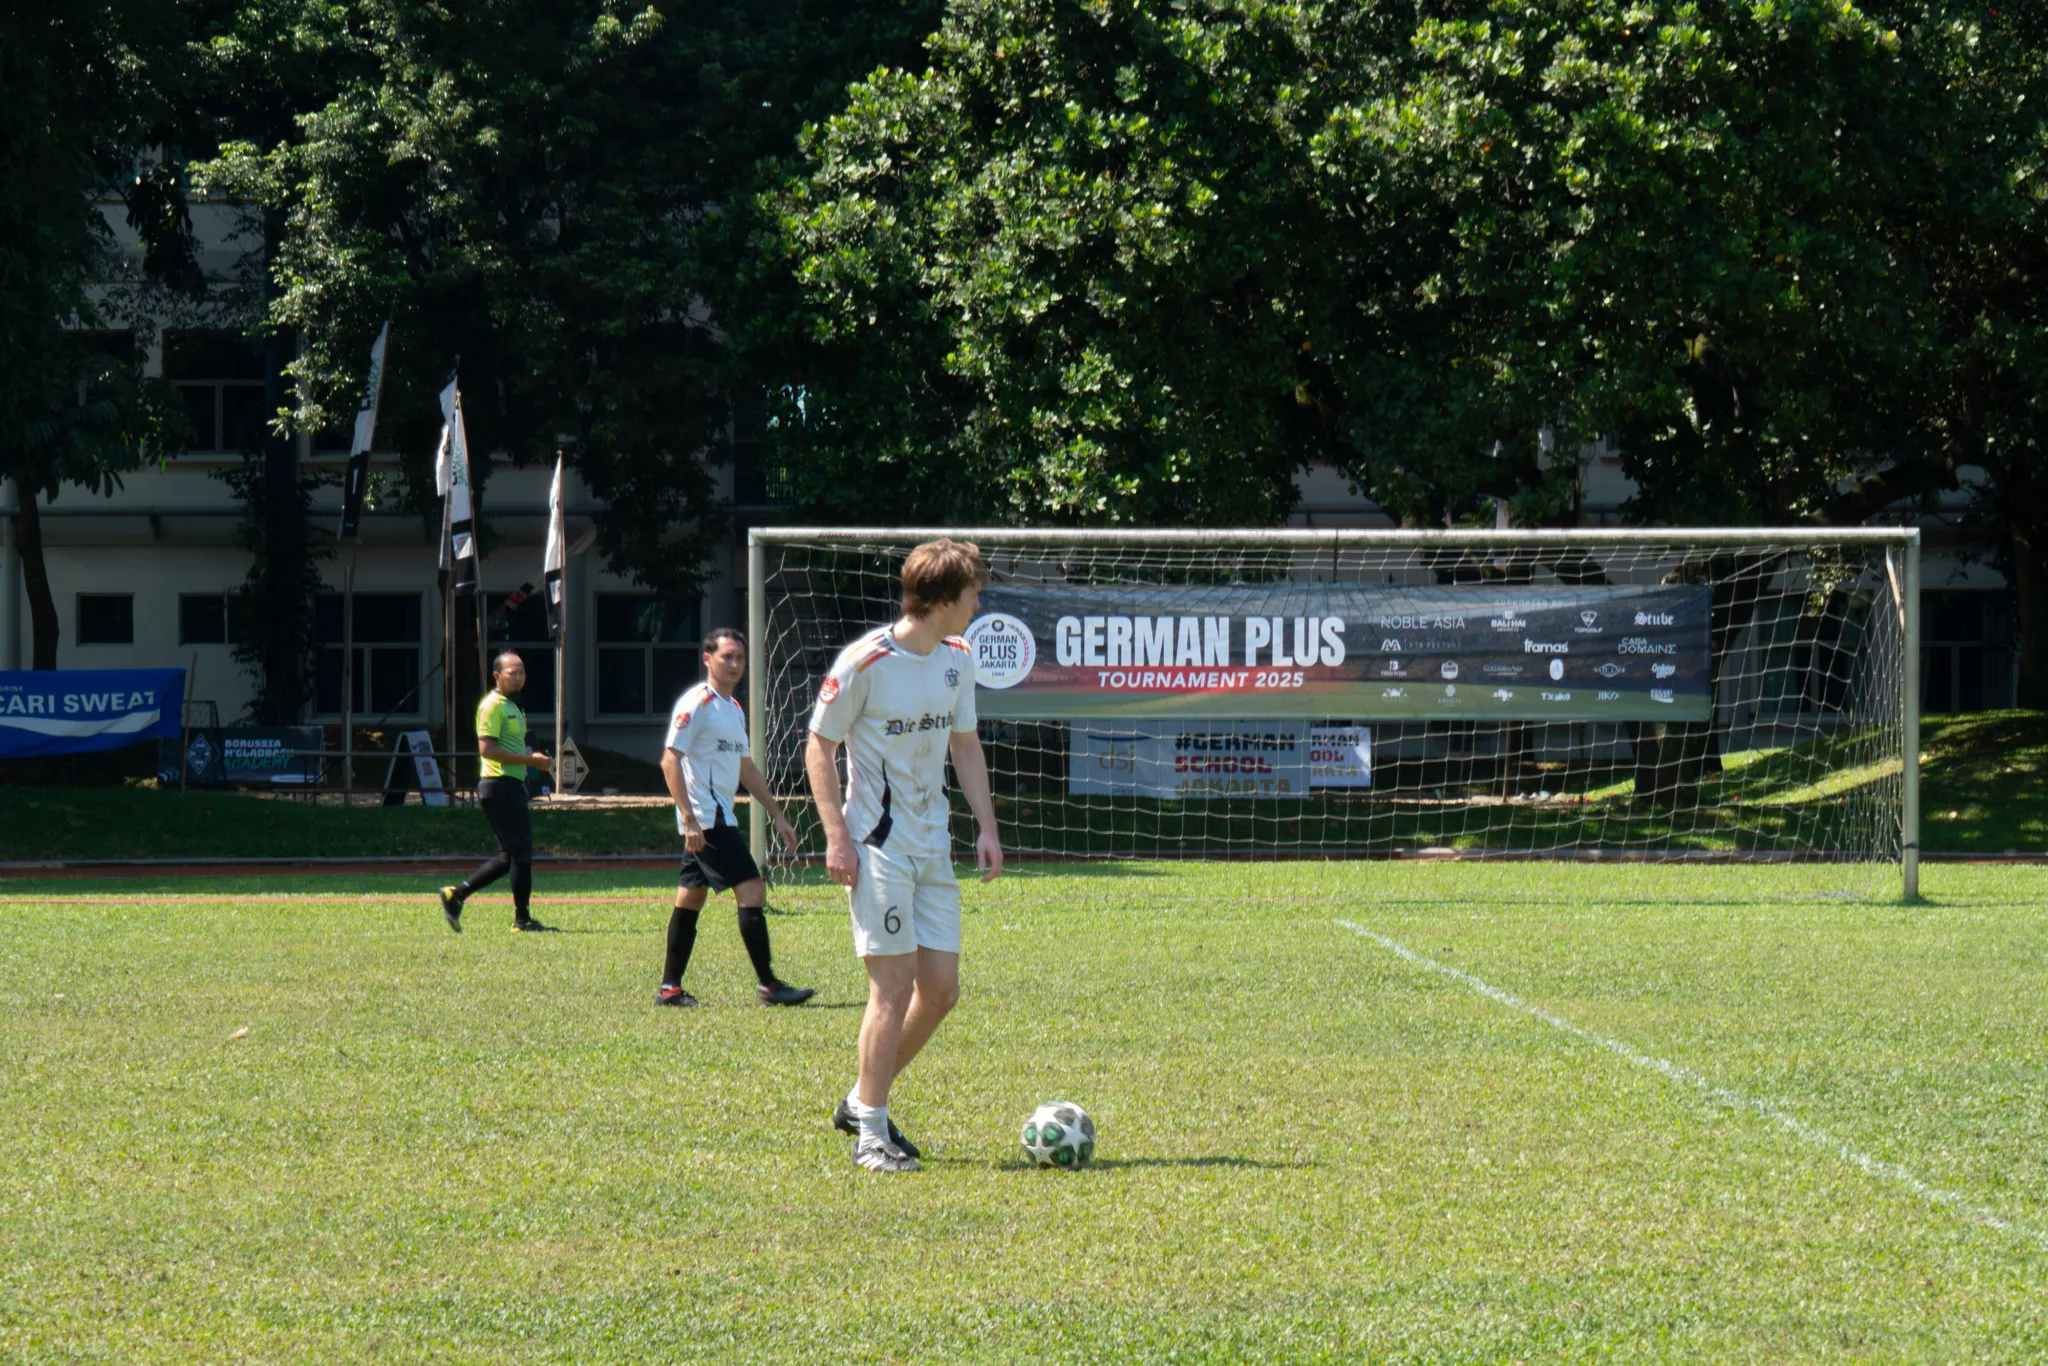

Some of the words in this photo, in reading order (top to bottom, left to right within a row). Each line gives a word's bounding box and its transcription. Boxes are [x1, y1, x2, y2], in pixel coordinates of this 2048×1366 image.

[1380, 615, 1428, 630] NOBLE
[1433, 615, 1466, 630] ASIA
[1634, 612, 1674, 626] Stube
[979, 634, 1018, 644] GERMAN
[1055, 615, 1230, 667] GERMAN
[1245, 615, 1346, 667] PLUS
[1523, 638, 1569, 653] framas
[979, 645, 1017, 660] PLUS
[979, 660, 1018, 669] JAKARTA
[1098, 671, 1249, 688] TOURNAMENT
[1255, 671, 1304, 688] 2025
[63, 691, 155, 714] SWEAT
[224, 739, 281, 748] BORUSSIA
[1175, 733, 1295, 752] #GERMAN
[1098, 745, 1136, 774] dsj
[1175, 756, 1273, 774] SCHOOL
[1175, 779, 1291, 797] JAKARTA
[884, 905, 901, 935] 6
